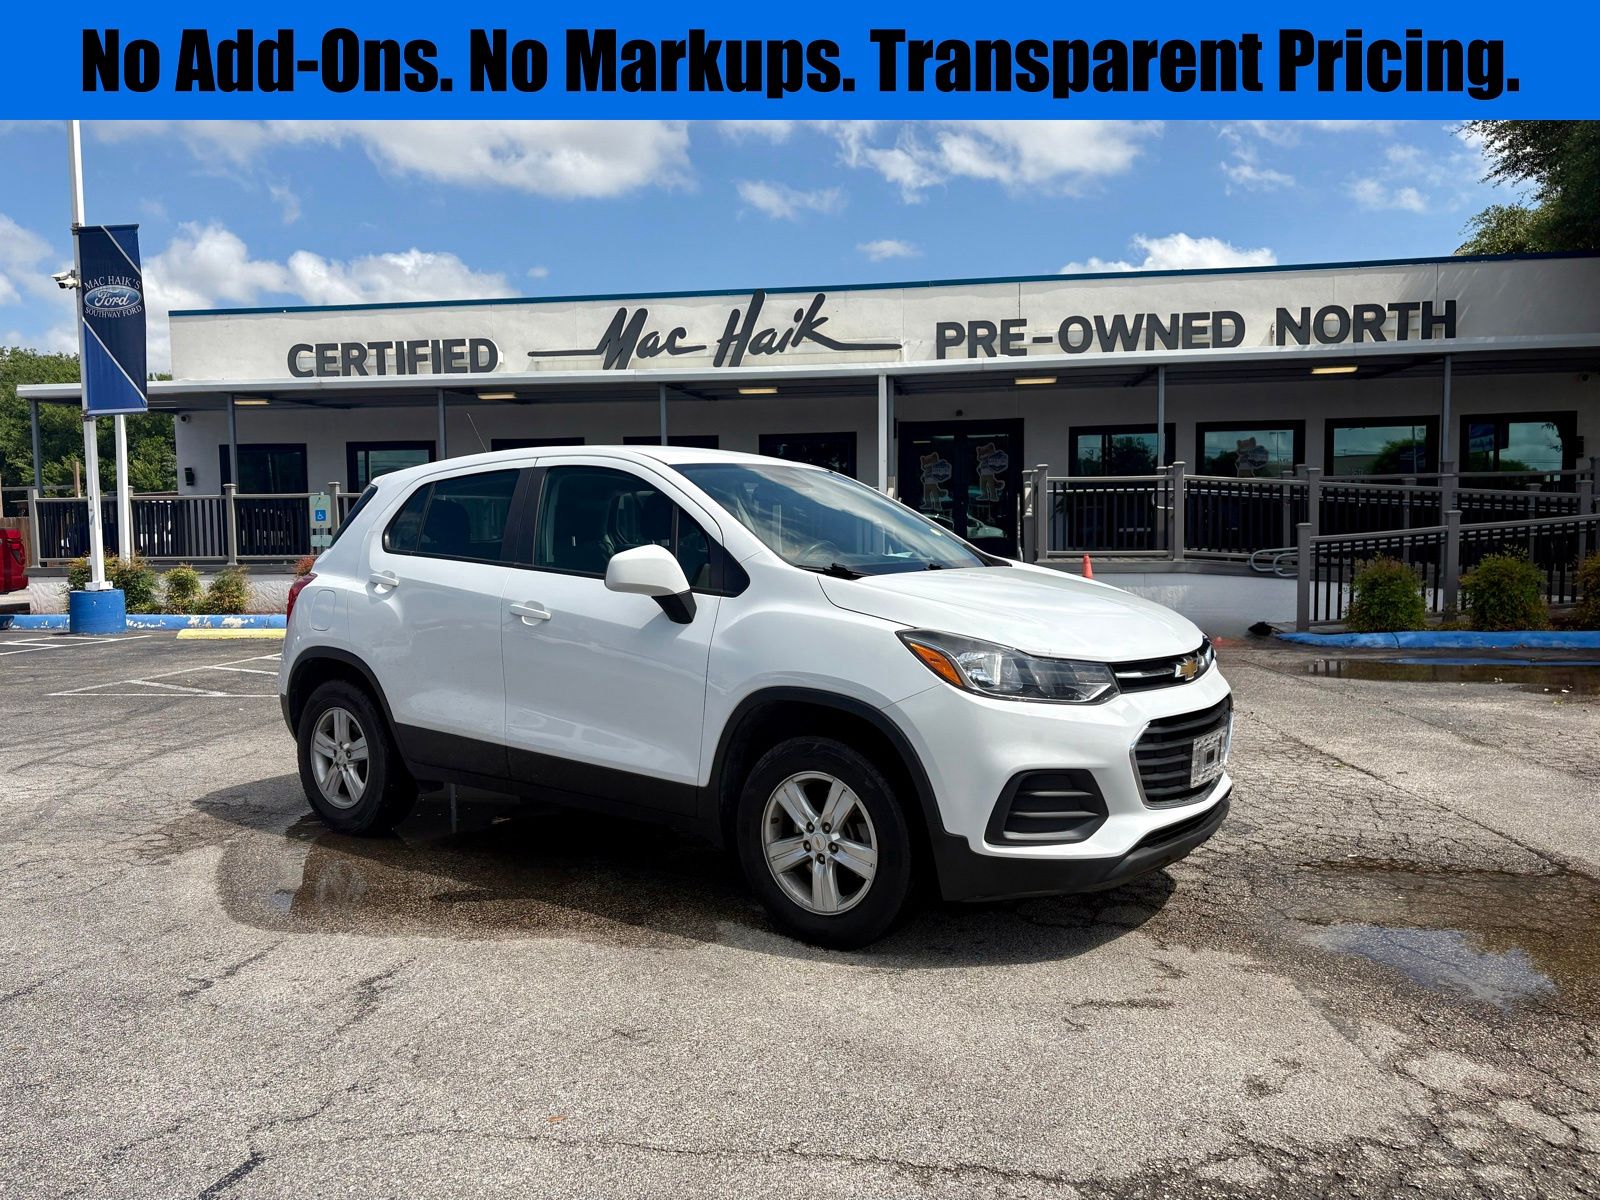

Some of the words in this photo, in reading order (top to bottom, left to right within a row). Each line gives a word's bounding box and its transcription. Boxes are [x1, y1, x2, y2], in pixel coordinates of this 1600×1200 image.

[84, 277, 105, 290] MAC
[107, 275, 140, 289] HAIK'S
[94, 290, 130, 306] Ford
[85, 306, 121, 318] SOUTHWAY
[122, 304, 142, 316] FORD
[287, 338, 499, 377] CERTIFIED
[527, 307, 707, 370] Mac
[712, 288, 902, 368] Haik
[936, 310, 1246, 360] PRE-OWNED
[1275, 300, 1456, 346] NORTH
